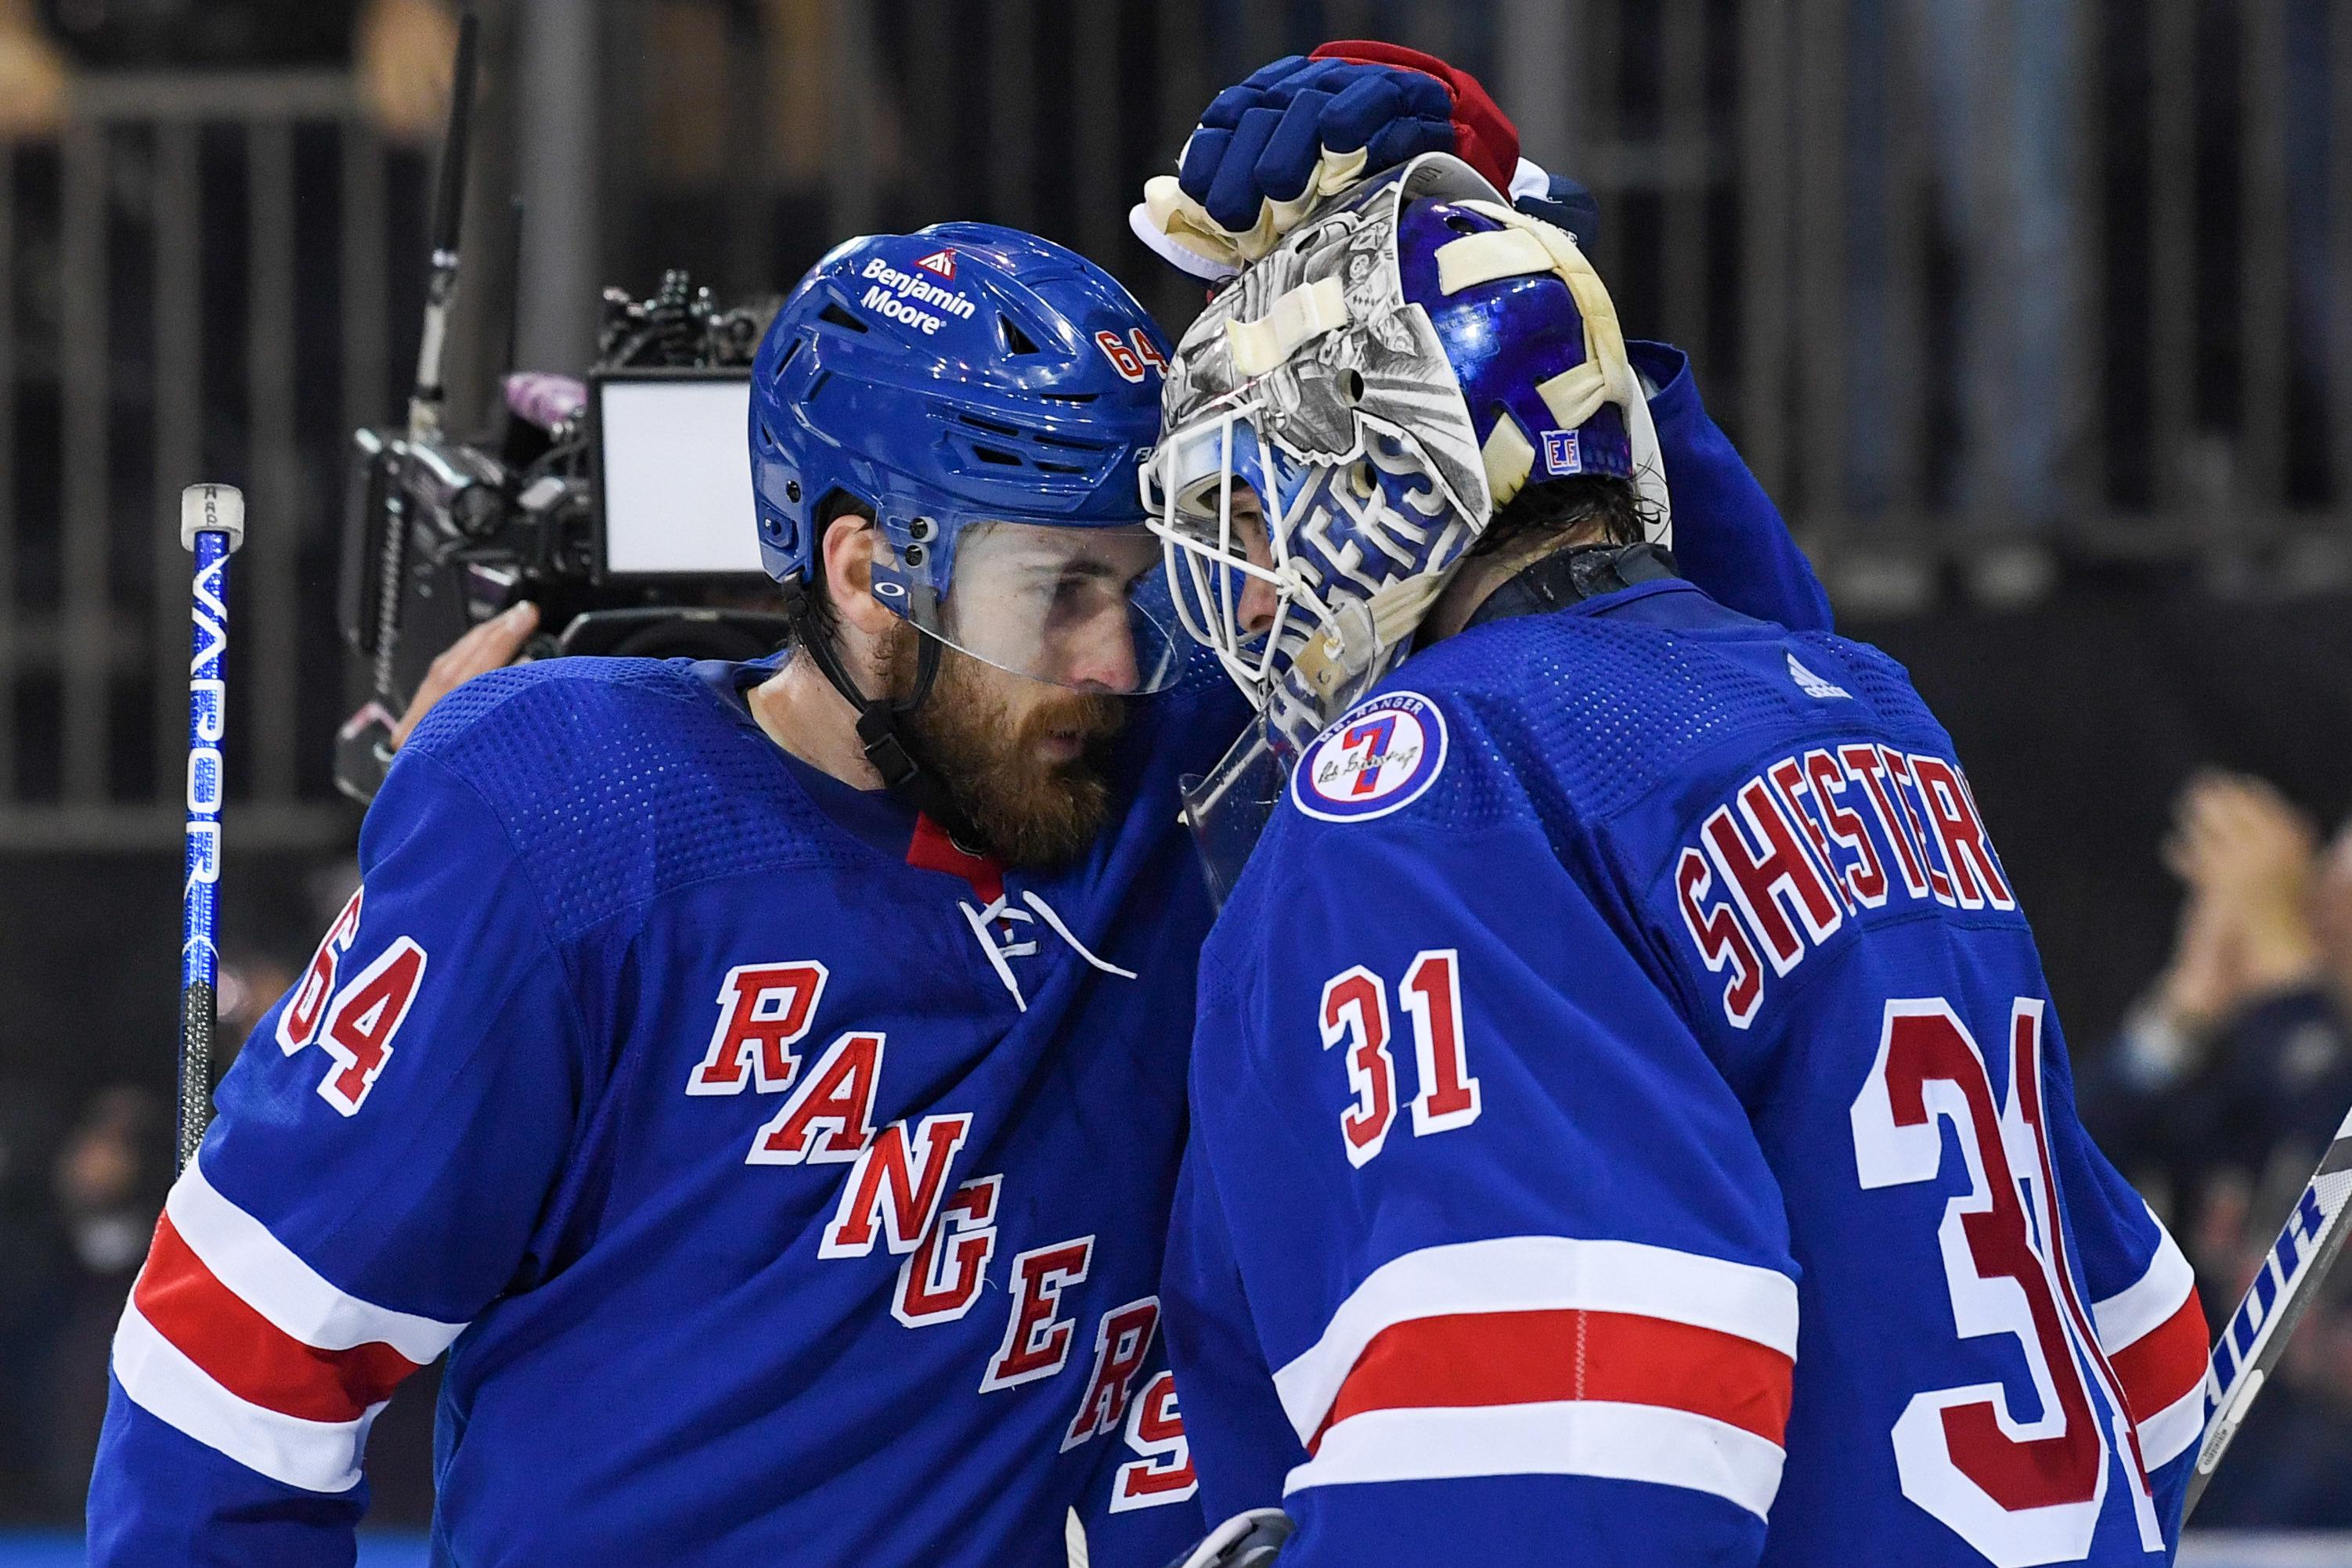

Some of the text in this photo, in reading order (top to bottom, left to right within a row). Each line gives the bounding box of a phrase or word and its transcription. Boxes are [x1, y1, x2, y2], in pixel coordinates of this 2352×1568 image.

[862, 258, 976, 319] Benjamin
[1095, 327, 1169, 384] 64
[1342, 715, 1397, 795] 7
[1356, 696, 1424, 719] RANGER
[1674, 742, 2025, 1030] SHESTER
[276, 885, 428, 1117] 64
[1318, 948, 1482, 1170] 31
[685, 959, 1199, 1514] RANGERS
[1850, 997, 2166, 1566] 31
